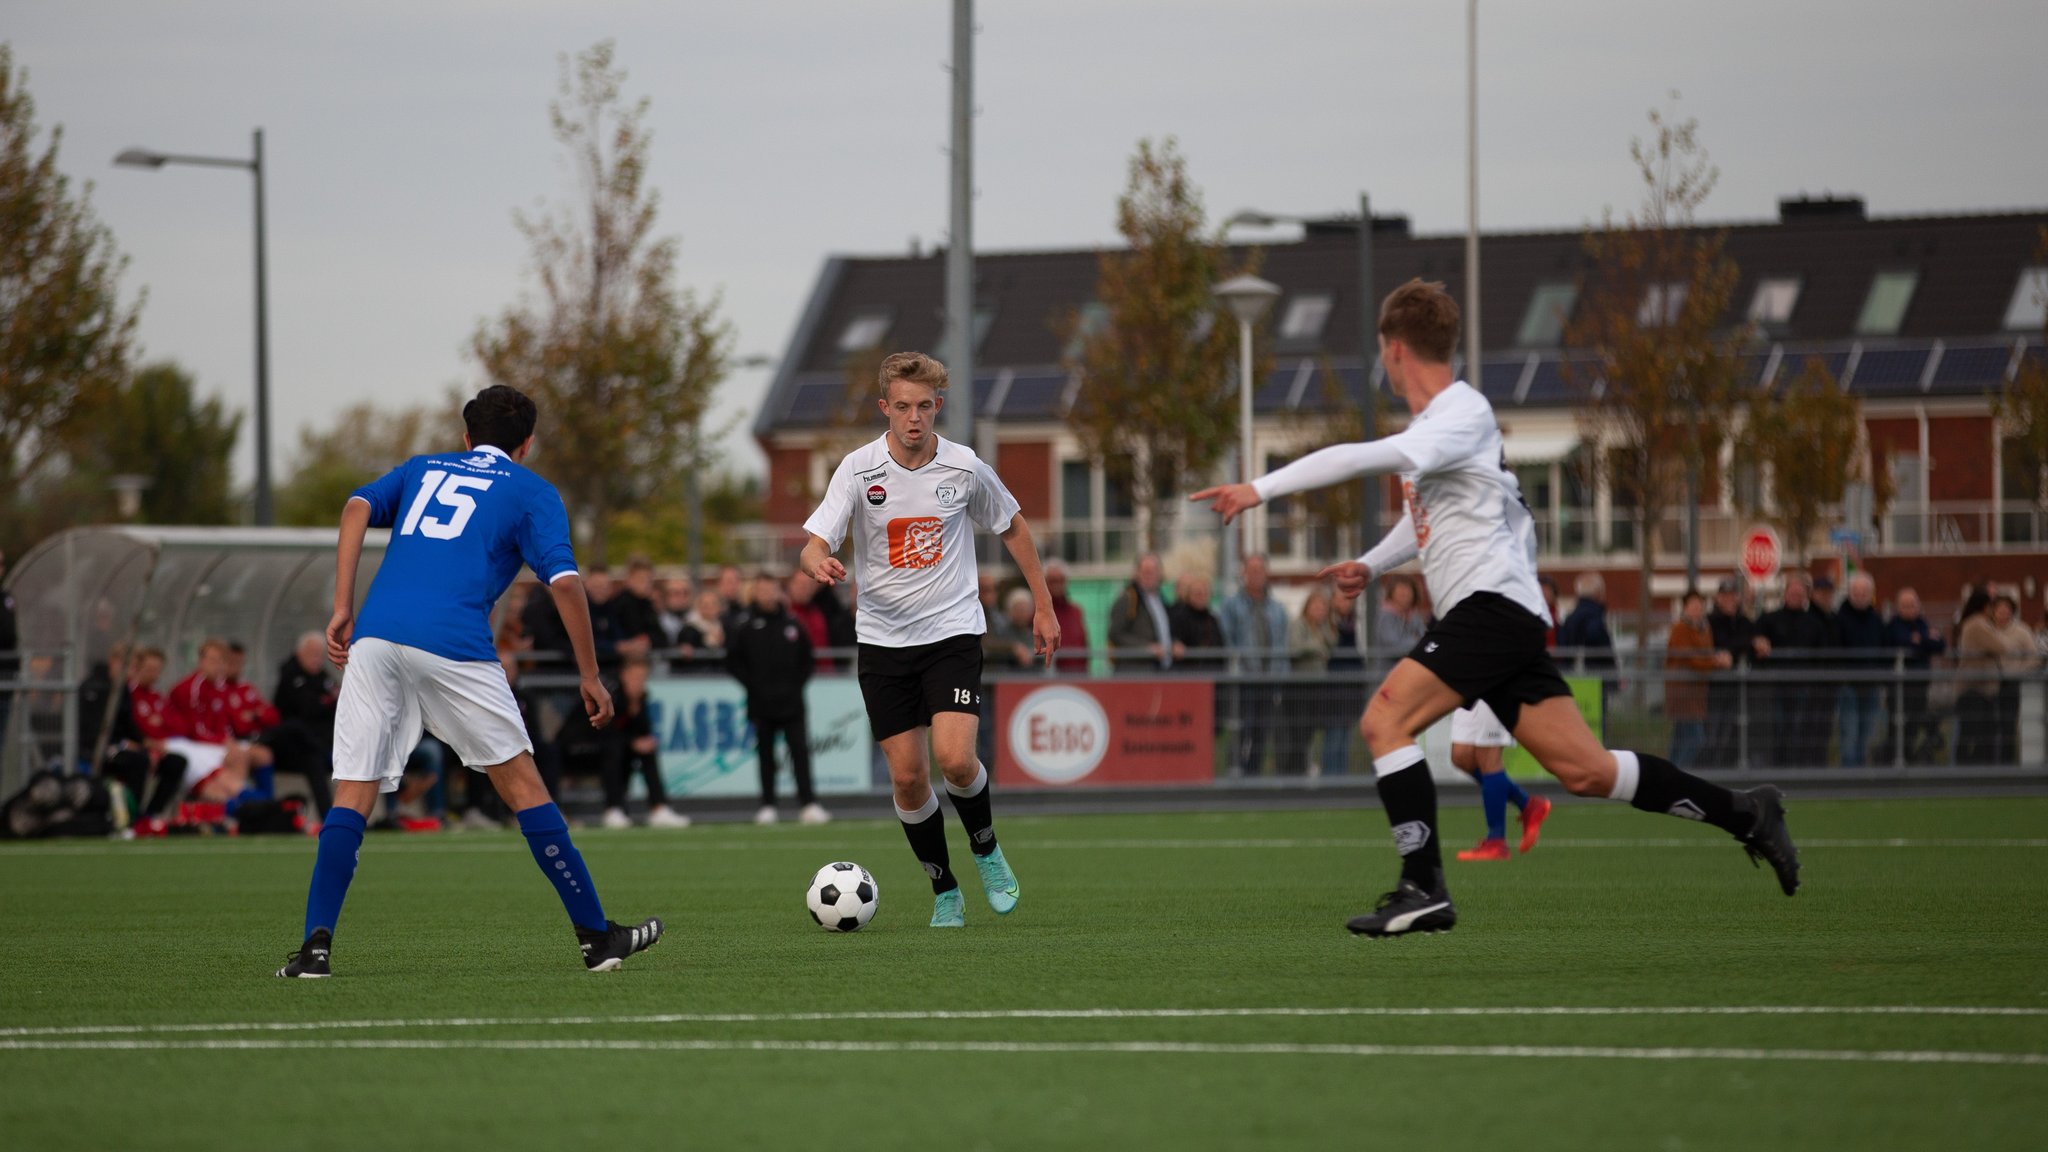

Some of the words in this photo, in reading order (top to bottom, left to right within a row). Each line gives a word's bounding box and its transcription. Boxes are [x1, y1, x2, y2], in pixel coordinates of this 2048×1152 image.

[863, 470, 887, 482] hummel
[400, 470, 493, 540] 15
[954, 688, 971, 705] 18
[1028, 713, 1095, 754] Esso
